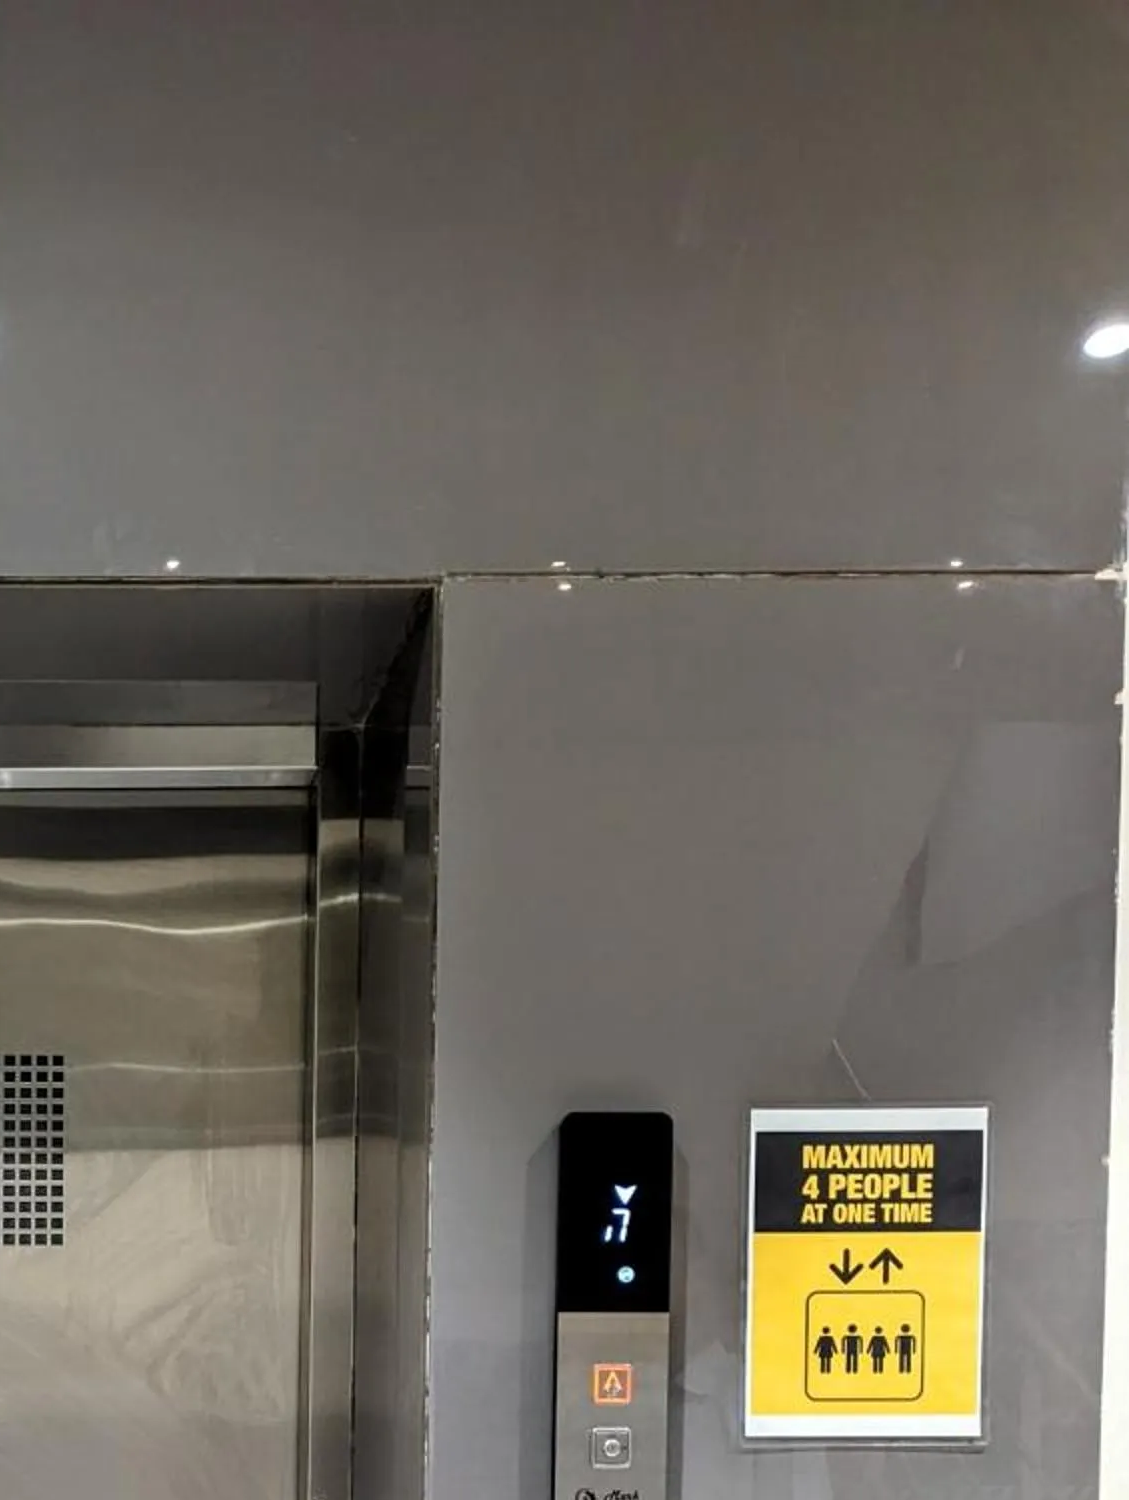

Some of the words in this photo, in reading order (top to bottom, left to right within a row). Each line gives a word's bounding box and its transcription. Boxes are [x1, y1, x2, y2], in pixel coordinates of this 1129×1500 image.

[802, 1143, 934, 1168] MAXIMUM
[802, 1174, 820, 1199] 4
[828, 1173, 933, 1199] PEOPLE
[801, 1203, 828, 1223] AT
[833, 1203, 875, 1223] ONE
[880, 1203, 933, 1223] TIME
